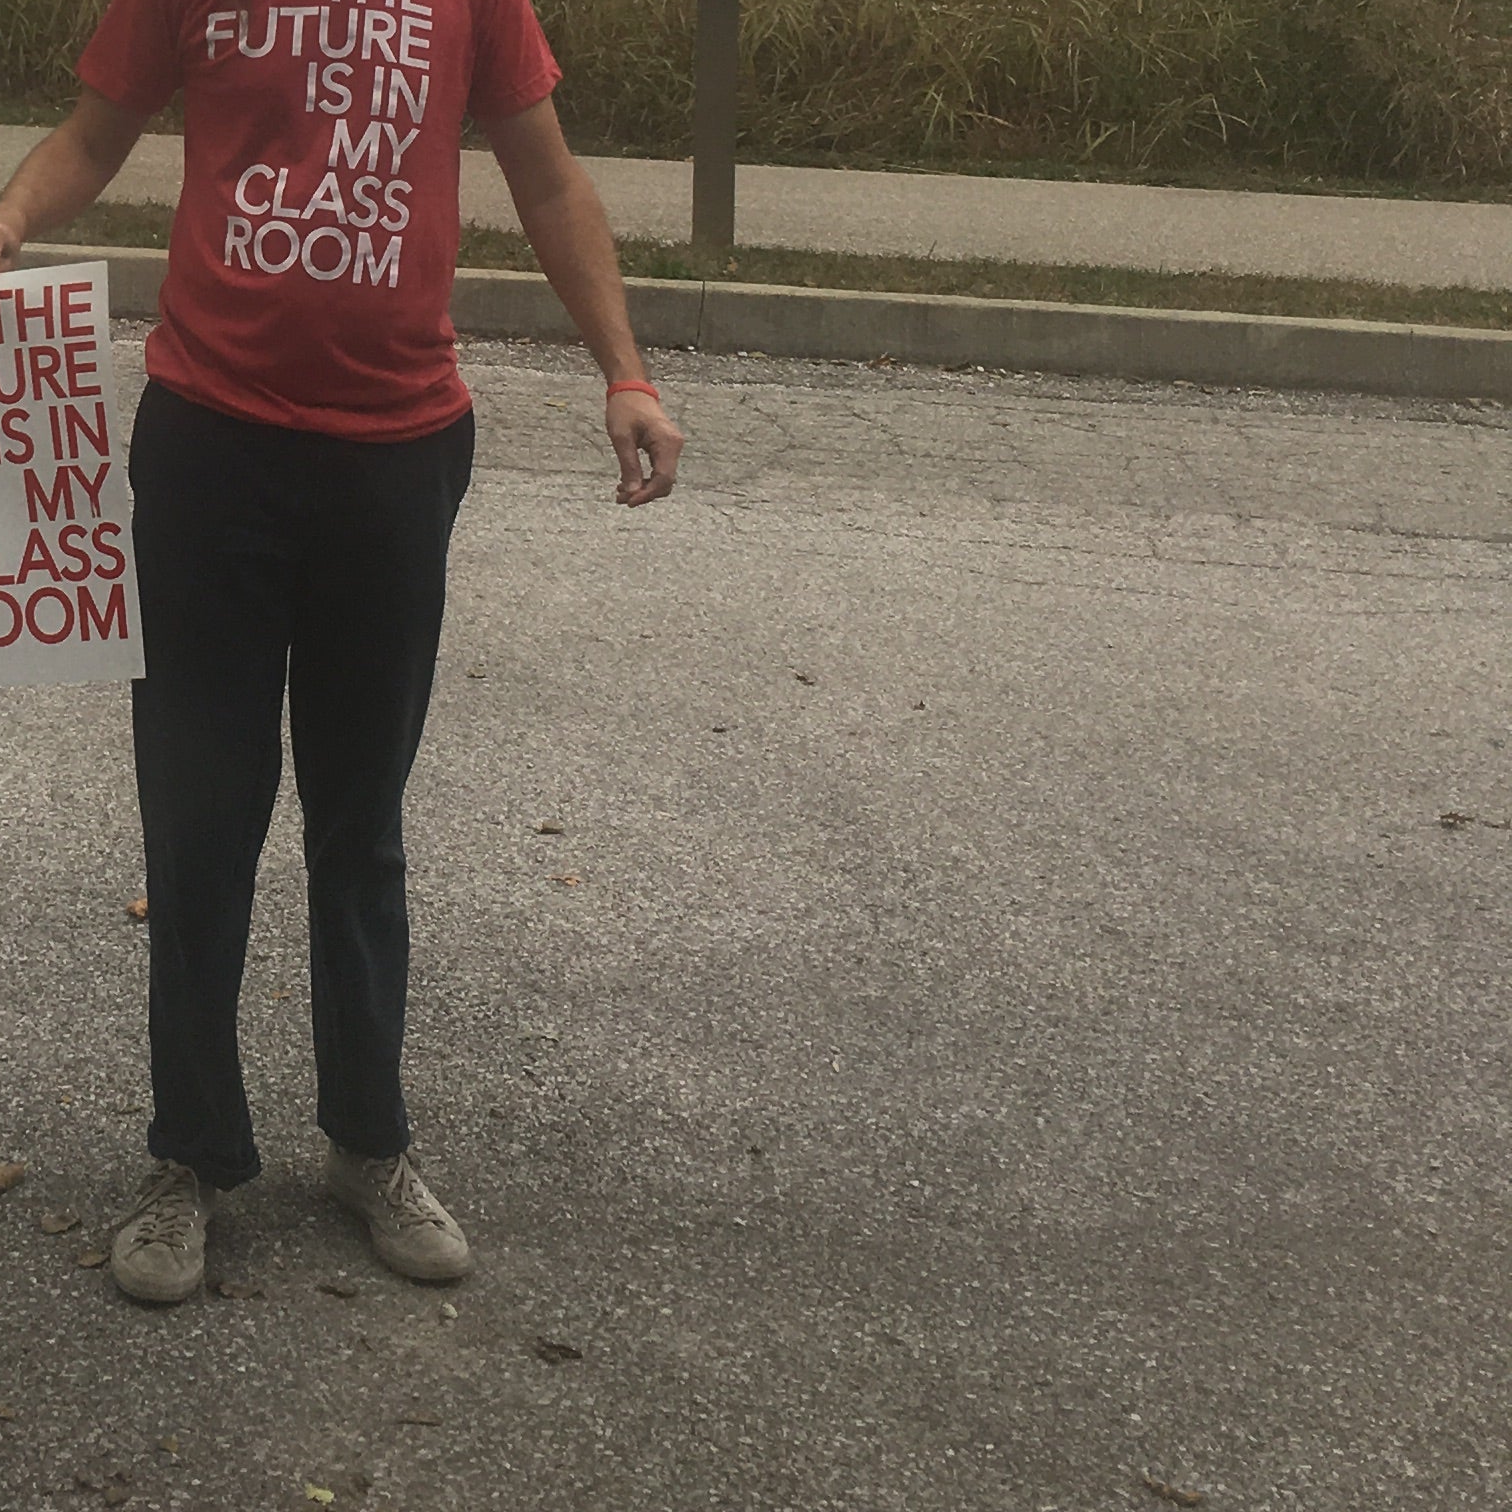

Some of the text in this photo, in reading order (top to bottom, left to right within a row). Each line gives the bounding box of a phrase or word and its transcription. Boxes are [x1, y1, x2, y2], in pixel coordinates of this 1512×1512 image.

[205, 5, 434, 71] FUTURE
[305, 61, 431, 125] IS IN
[327, 118, 421, 176] MY
[234, 163, 414, 233] CLASS
[223, 214, 403, 289] ROOM
[48, 401, 110, 461] IN
[23, 462, 112, 524] MY
